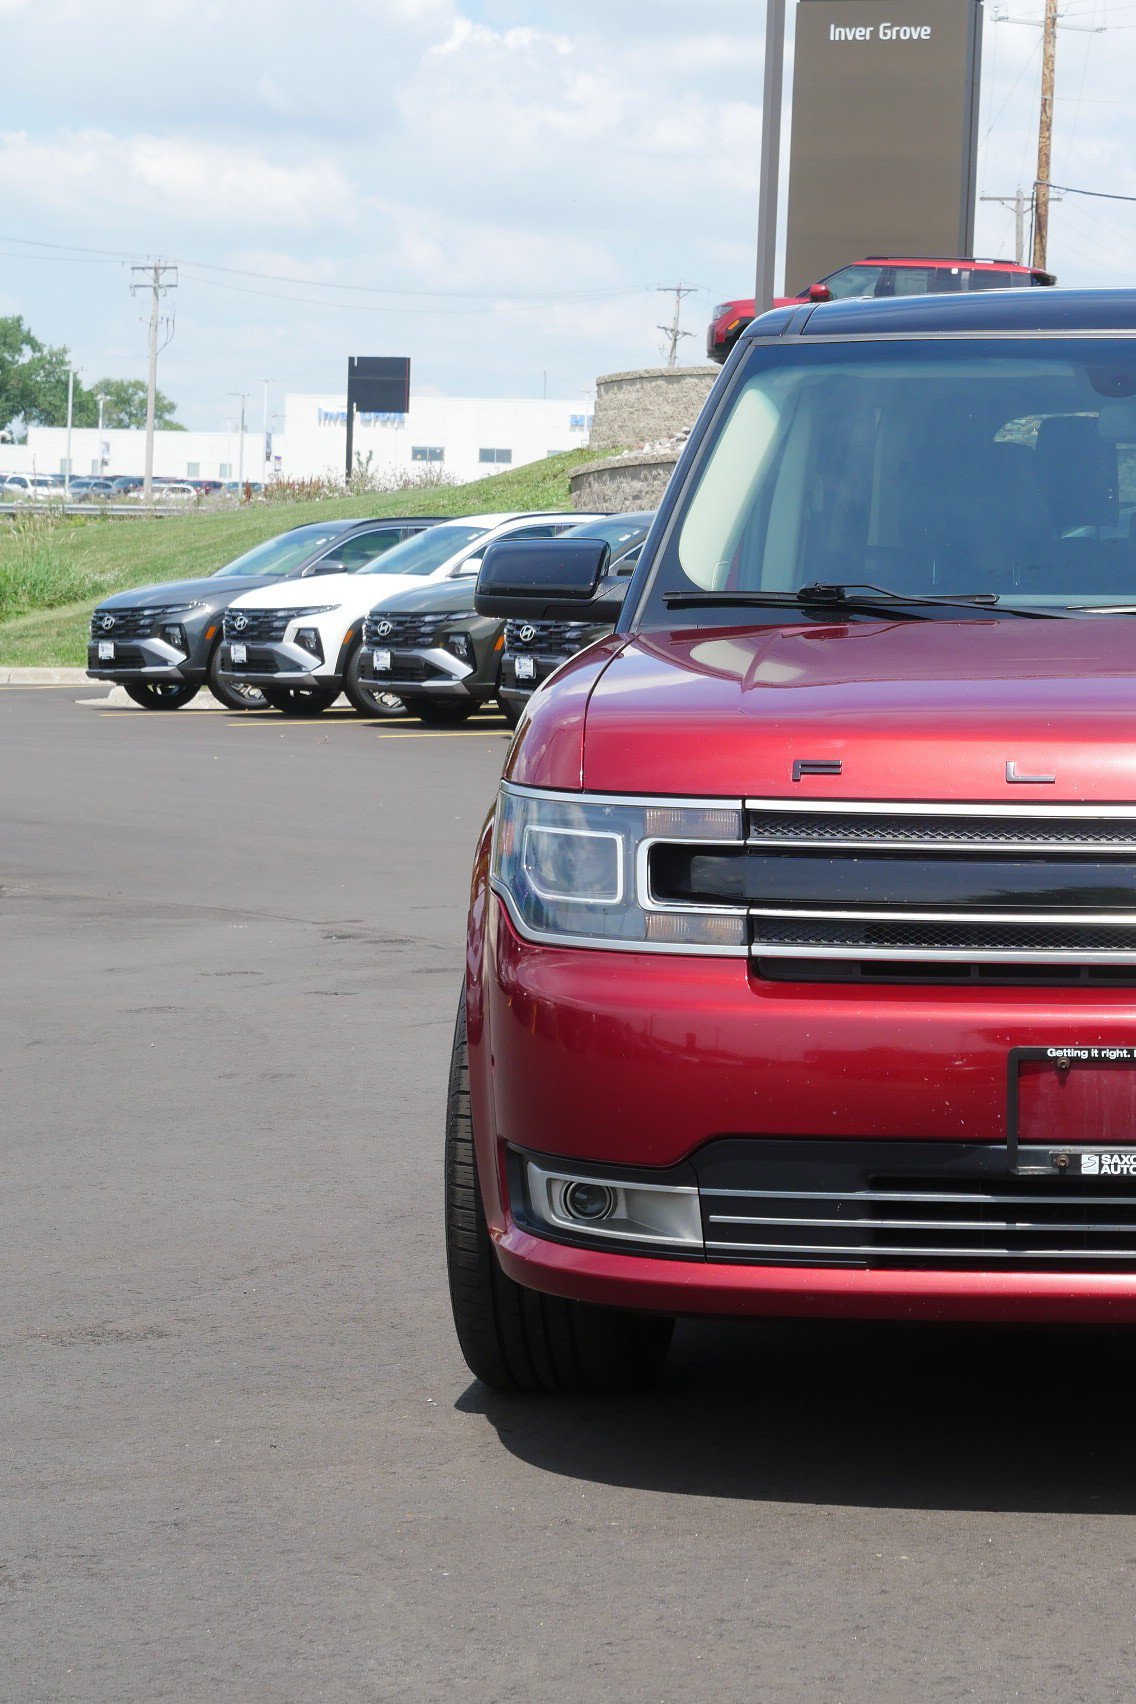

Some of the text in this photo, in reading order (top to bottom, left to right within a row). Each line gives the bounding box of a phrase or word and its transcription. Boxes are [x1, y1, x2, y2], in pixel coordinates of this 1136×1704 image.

[829, 22, 931, 40] Inver Grove
[1046, 1048, 1089, 1059] Getting
[1091, 1048, 1099, 1058] it
[1101, 1048, 1131, 1060] right.
